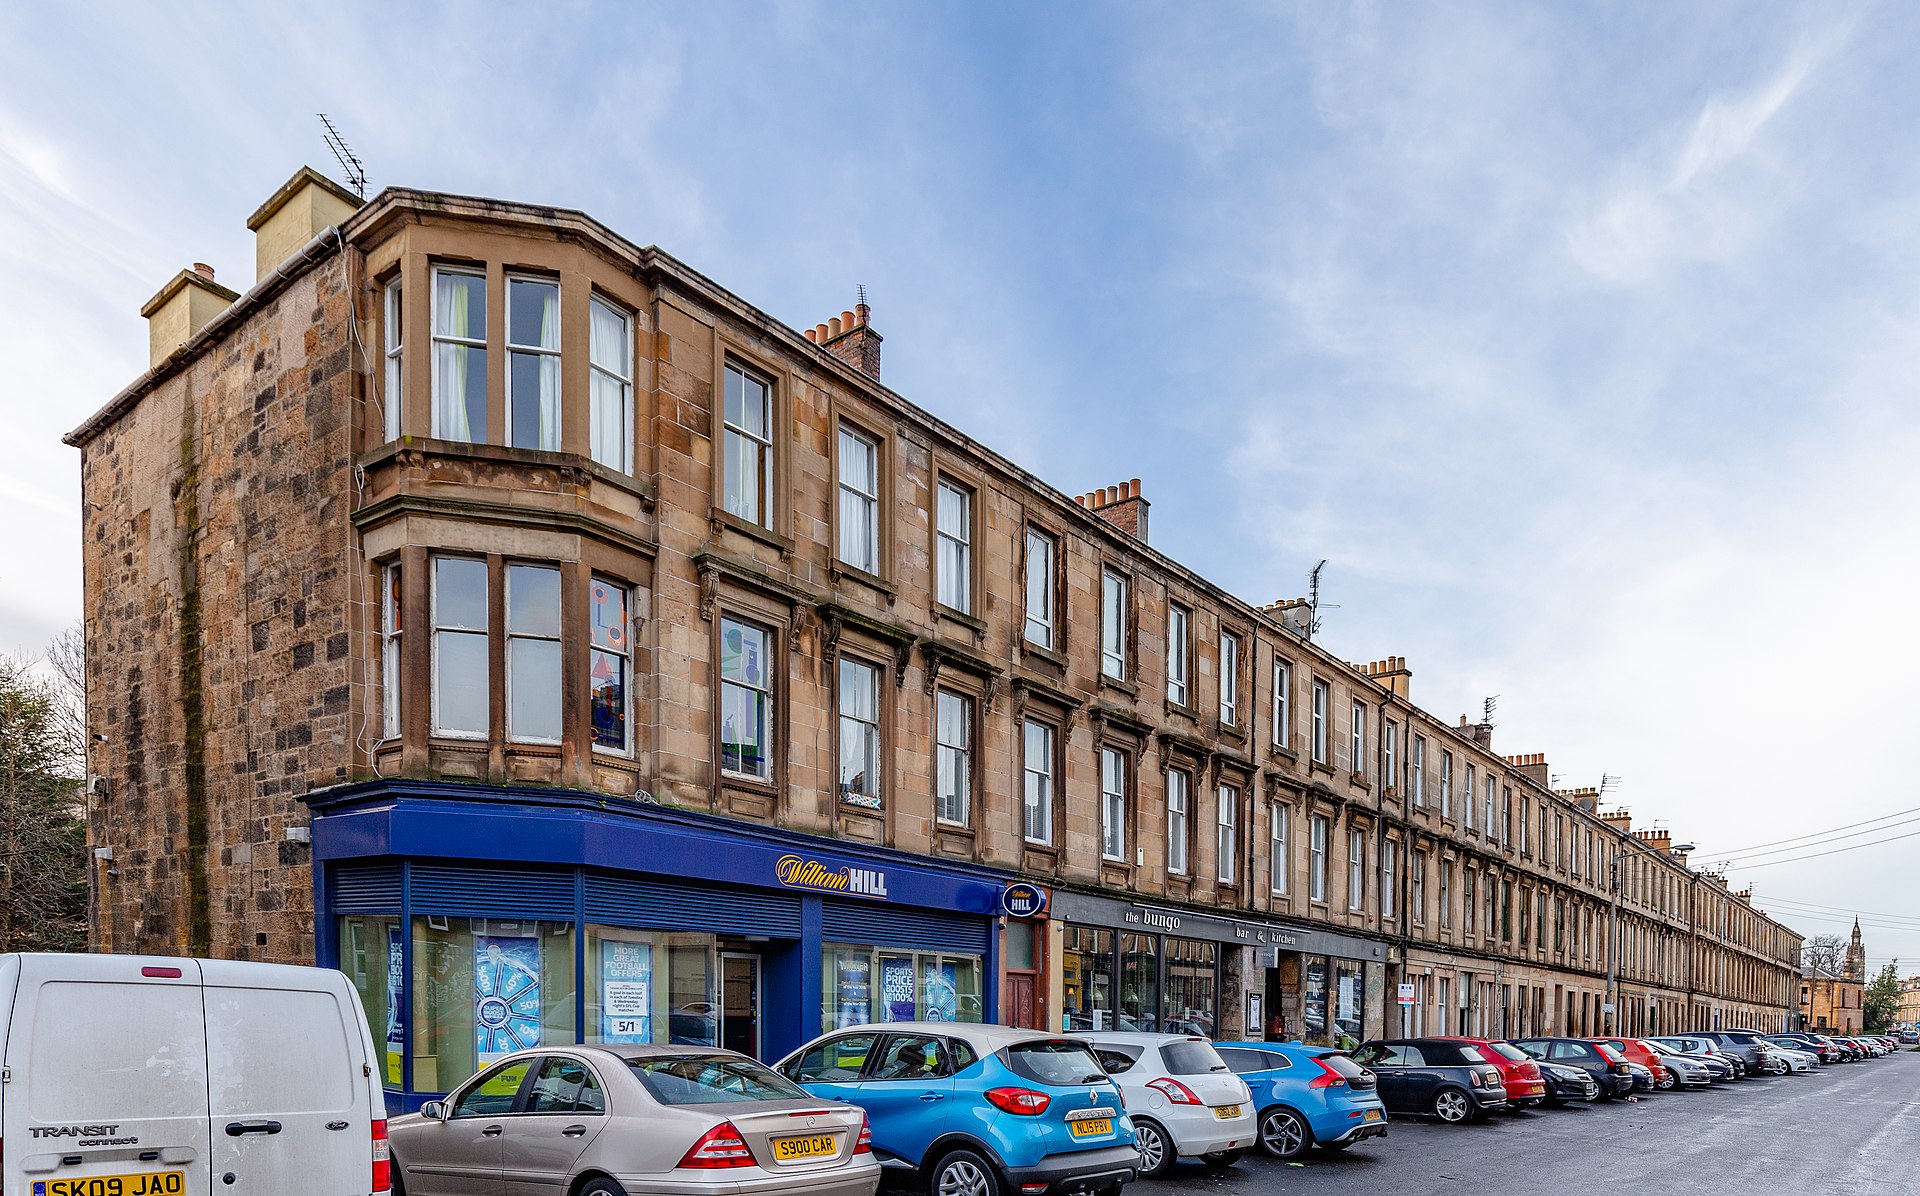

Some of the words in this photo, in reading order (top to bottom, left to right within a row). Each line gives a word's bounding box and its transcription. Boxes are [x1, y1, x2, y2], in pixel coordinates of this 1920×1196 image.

[775, 854, 850, 890] William
[850, 868, 887, 896] HILL
[1011, 899, 1031, 910] HILL
[1125, 911, 1138, 923] the
[1143, 909, 1180, 932] bungo
[1235, 927, 1249, 939] bar
[1256, 930, 1266, 943] &
[1270, 931, 1296, 945] kitchen
[614, 947, 639, 956] MORE
[605, 961, 648, 970] FOOTBALL
[885, 966, 913, 976] SPORTS
[478, 965, 491, 993] 100%
[610, 969, 642, 978] OFFERS
[885, 975, 913, 986] PRICE
[505, 972, 522, 993] 40%
[885, 984, 913, 994] BOOSTS
[519, 1023, 537, 1040] 10%
[618, 1021, 635, 1032] 5/1
[28, 1124, 120, 1138] TRANSIT
[1076, 1121, 1094, 1135] NL15
[78, 1136, 139, 1146] connect
[780, 1139, 811, 1156] S900
[812, 1137, 833, 1152] CAR
[51, 1177, 124, 1196] SK09
